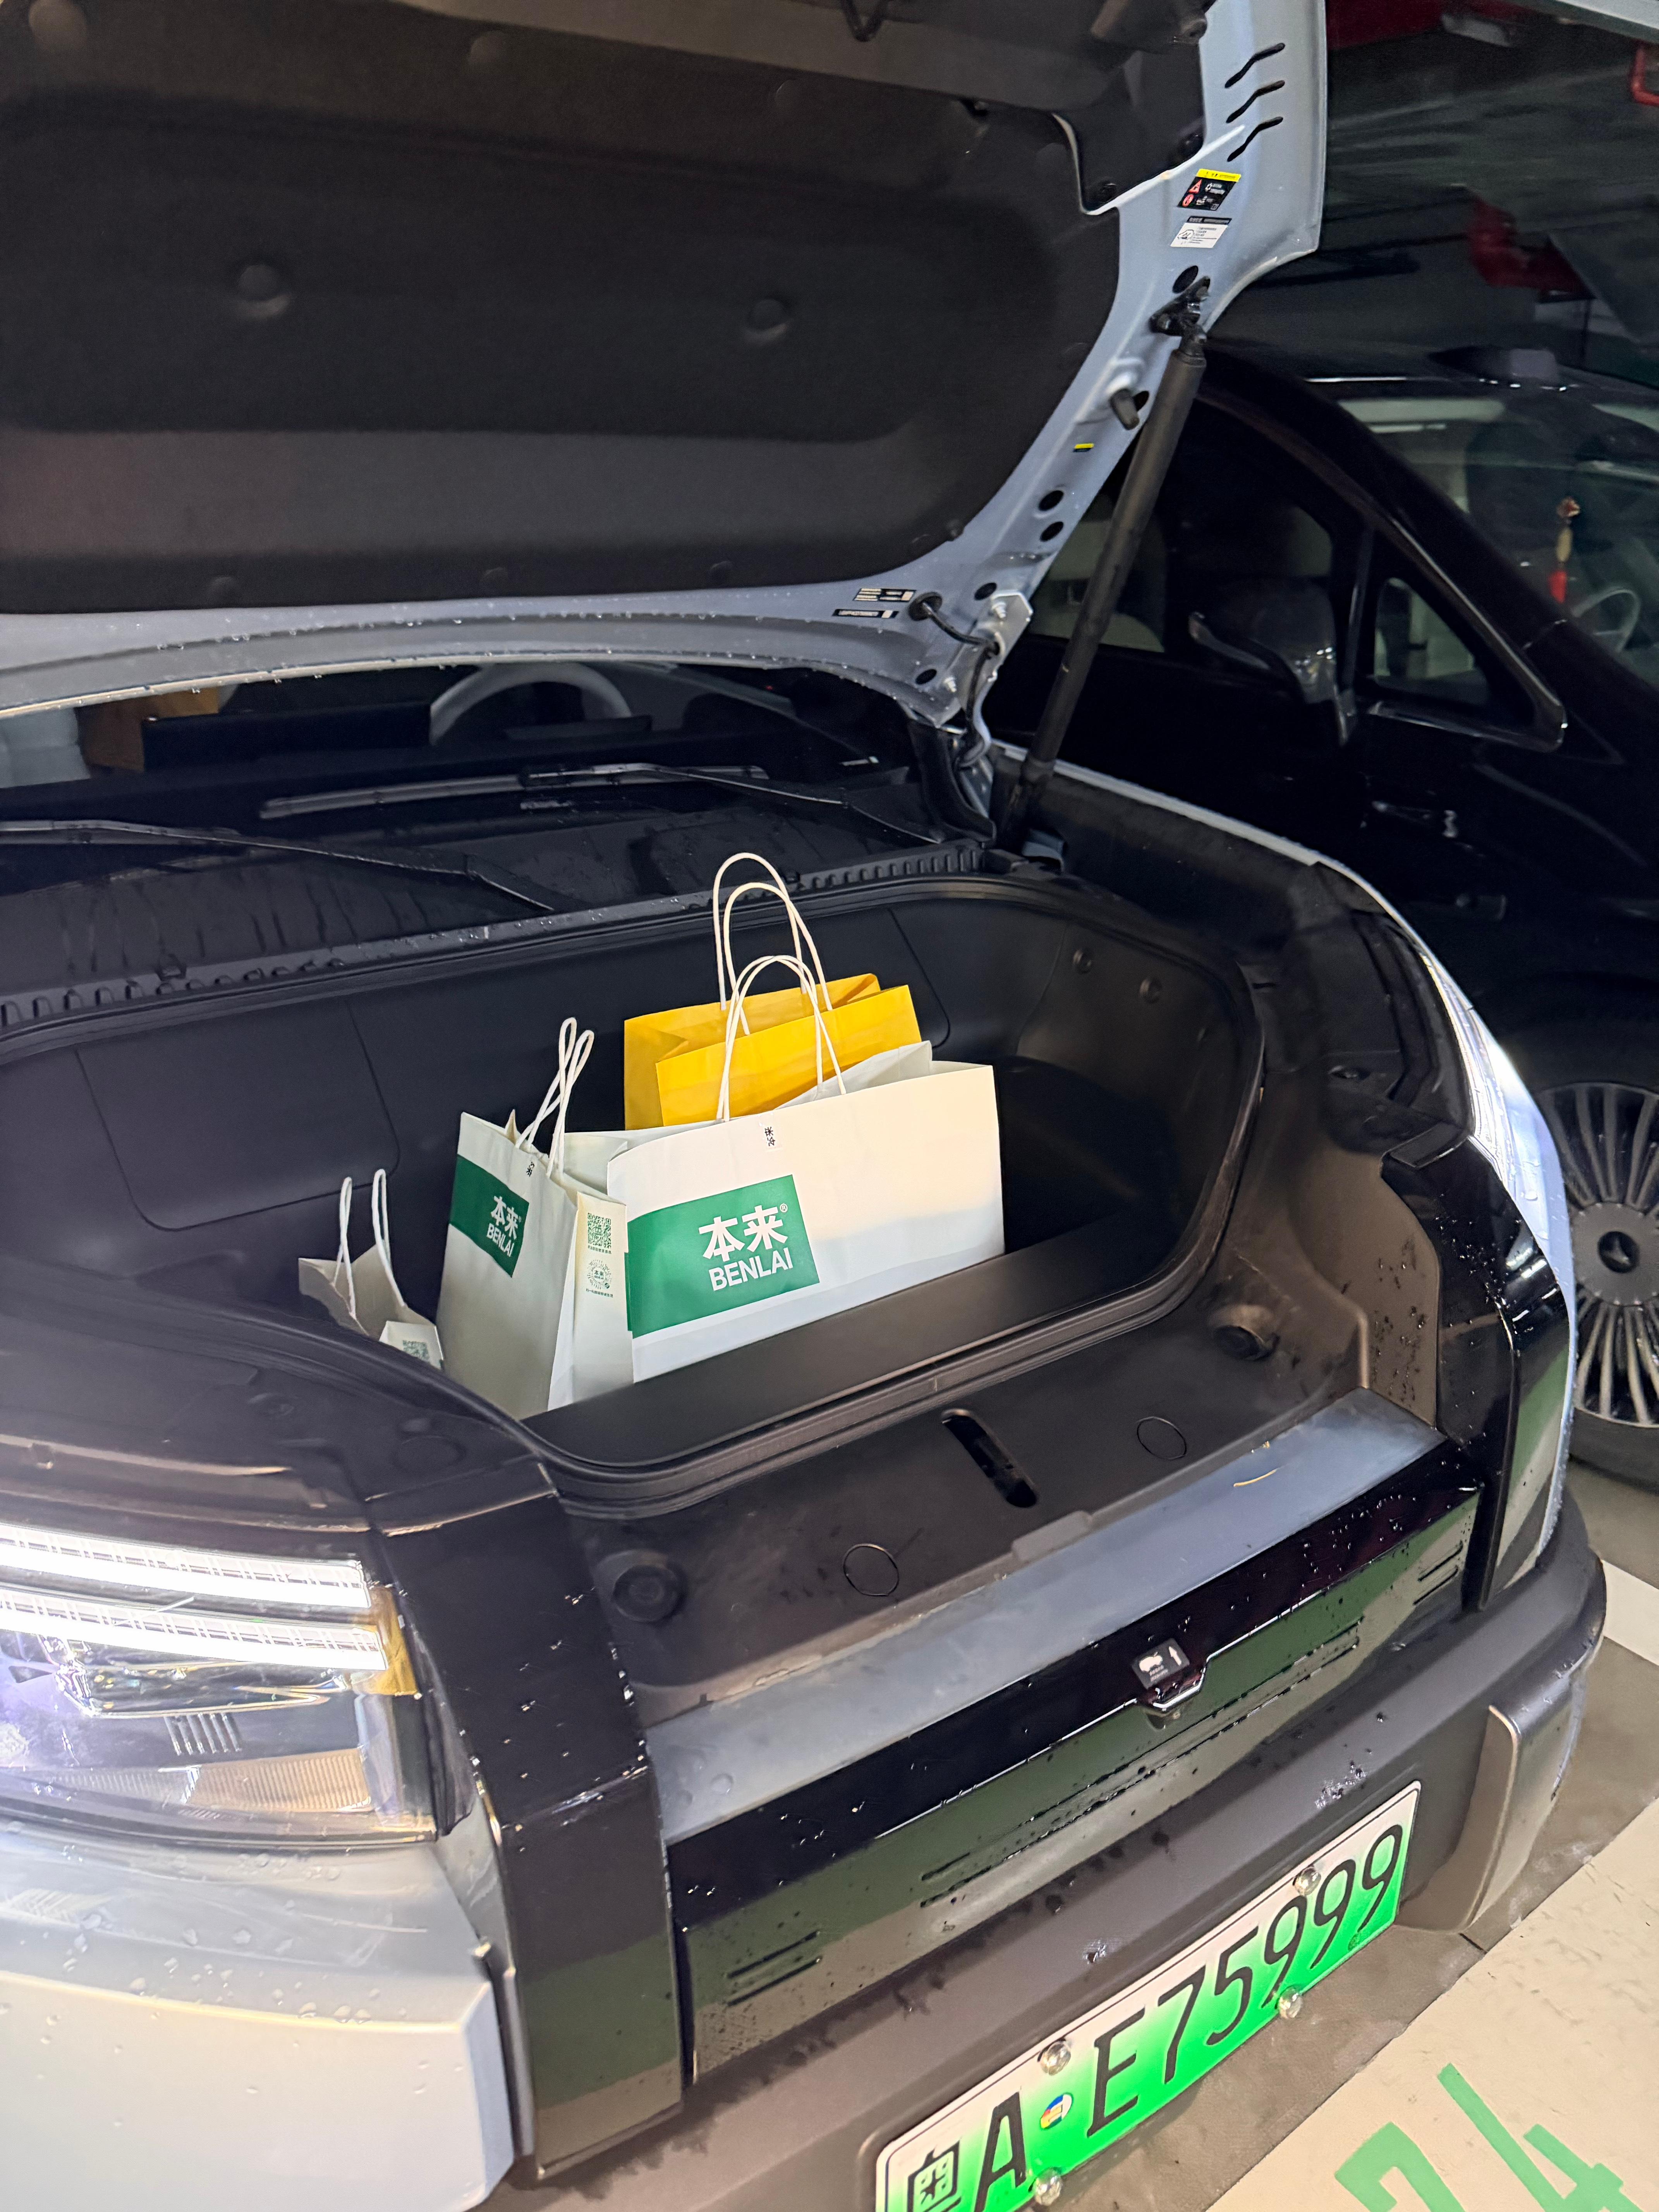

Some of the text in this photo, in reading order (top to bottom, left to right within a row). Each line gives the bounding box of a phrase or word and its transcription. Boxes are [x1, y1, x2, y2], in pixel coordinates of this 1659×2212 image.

[486, 1223, 515, 1257] BENLAI
[490, 1195, 519, 1240] 本来
[698, 1205, 788, 1262] 本来
[708, 1247, 793, 1291] BENLAI
[1086, 1823, 1403, 2138] E75999
